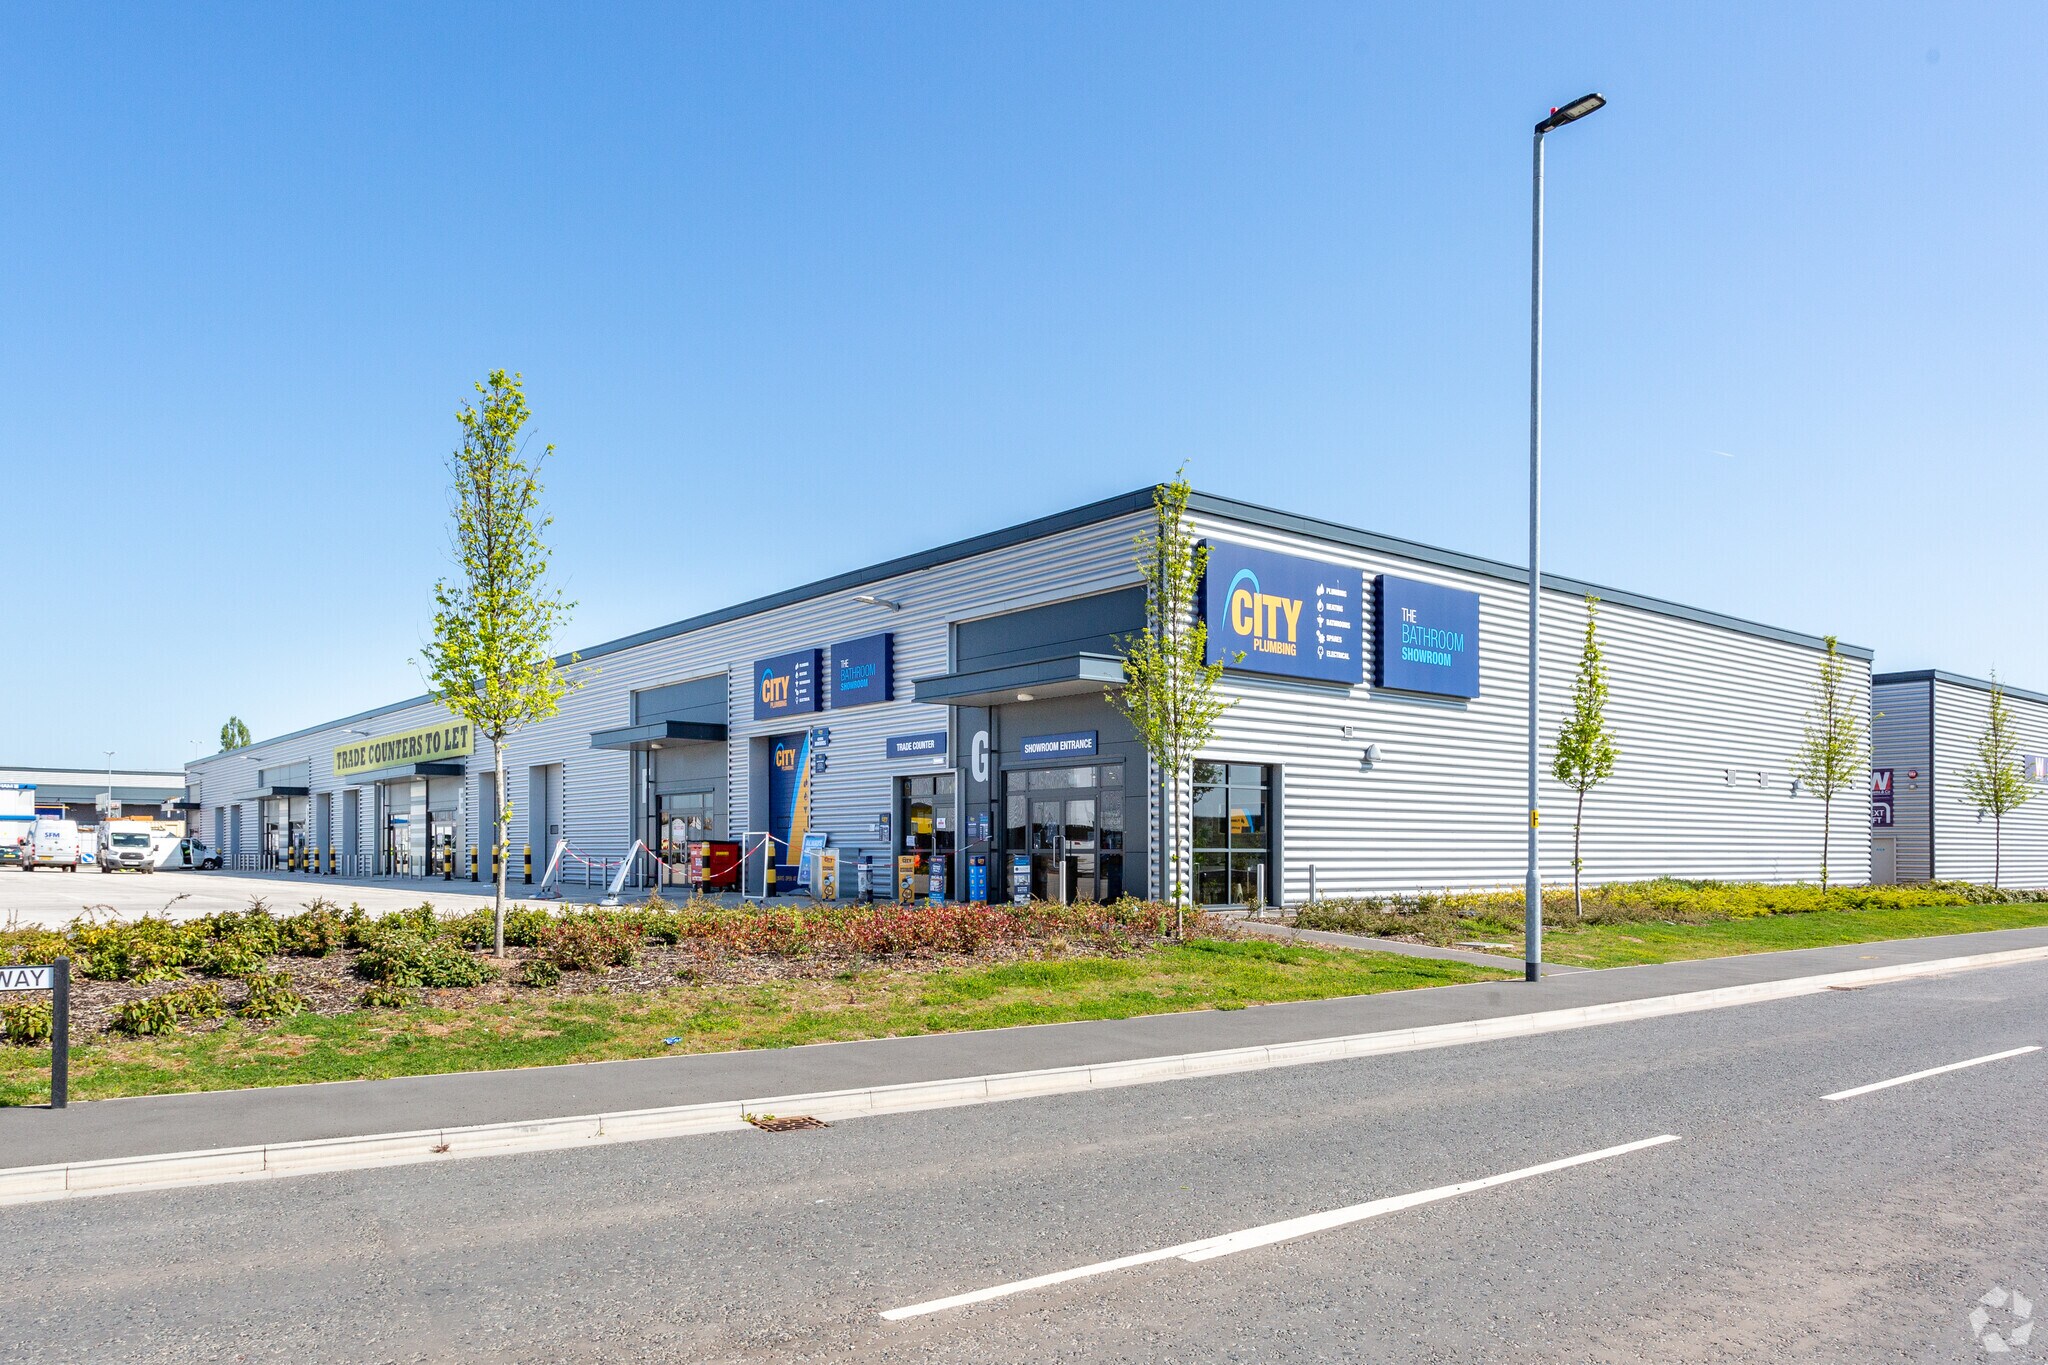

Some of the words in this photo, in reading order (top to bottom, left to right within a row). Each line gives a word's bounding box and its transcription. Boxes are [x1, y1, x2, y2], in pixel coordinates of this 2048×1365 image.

[1231, 589, 1303, 642] CITY
[1401, 607, 1416, 623] THE
[1253, 637, 1297, 656] PLUMBING
[1402, 624, 1464, 652] BATHROOM
[840, 659, 849, 668] THE
[1402, 648, 1452, 667] SHOWROOM
[841, 663, 876, 682] BATHROOM
[762, 675, 790, 703] CITY
[337, 747, 366, 770] TRADE
[368, 734, 422, 764] COUNTERS
[425, 731, 441, 754] TO
[444, 725, 468, 751] LET
[896, 742, 912, 752] TRADE
[913, 739, 935, 751] COUNTER
[1024, 741, 1059, 754] SHOWROOM
[1060, 738, 1093, 751] ENTRANCE
[775, 749, 796, 767] CITY
[971, 730, 989, 783] G
